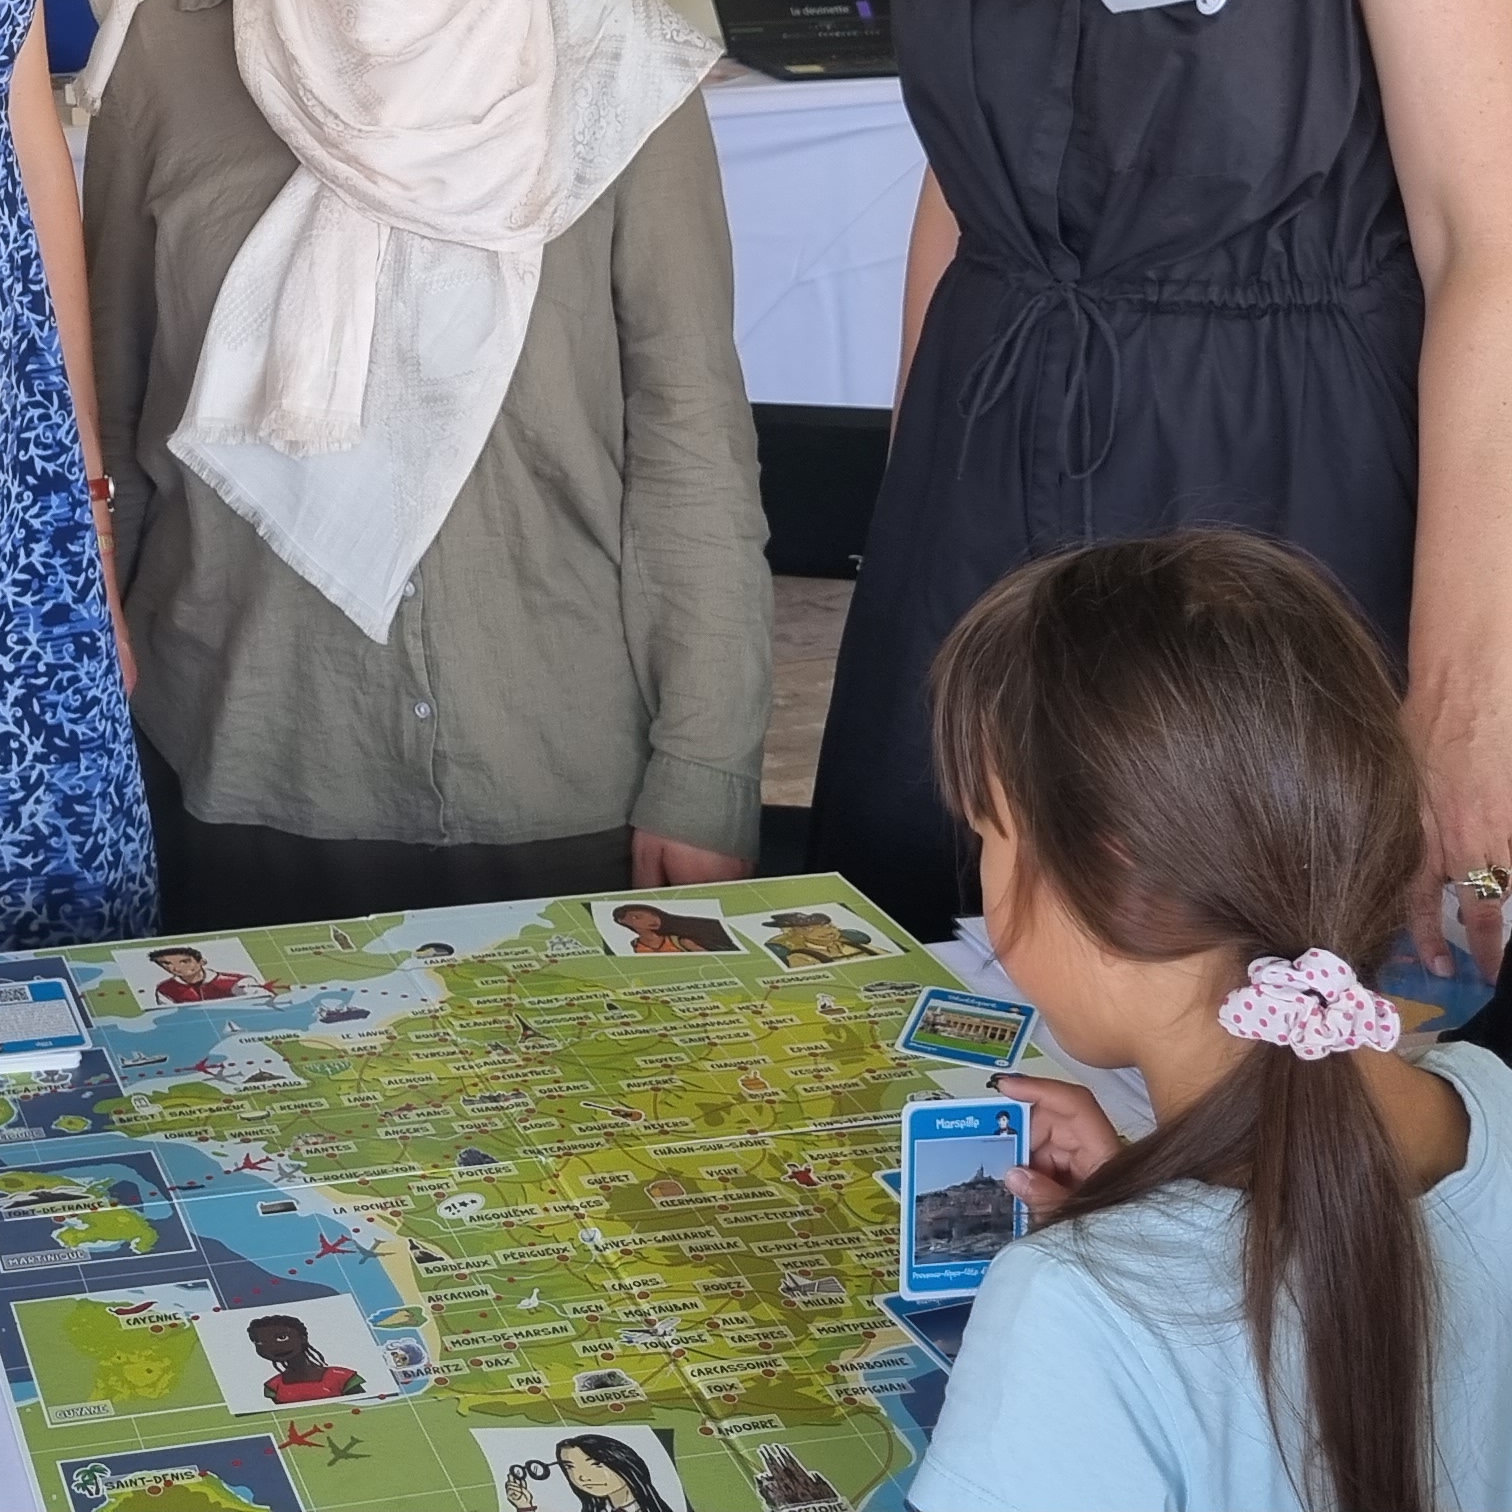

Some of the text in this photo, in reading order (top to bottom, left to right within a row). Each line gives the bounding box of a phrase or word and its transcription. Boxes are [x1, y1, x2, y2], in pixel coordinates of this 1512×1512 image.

[802, 4, 851, 16] devinette
[290, 942, 335, 953] LONDRES
[424, 956, 458, 966] CALAIS
[512, 962, 536, 970] LILLE
[480, 977, 506, 986] LENS
[763, 973, 830, 985] LUXEMBOURG
[476, 996, 516, 1006] AMIENS
[528, 993, 611, 1006] SAINT-QUENTIN
[670, 993, 705, 1003] SEDAN
[678, 1004, 720, 1014] VERDUN
[737, 1003, 768, 1012] METZ
[534, 1014, 592, 1025] SOISSONS
[762, 1017, 795, 1026] NANCY
[832, 1010, 902, 1022] STRASBOURG
[459, 1018, 512, 1029] BEAUVAIS
[239, 1033, 300, 1044] CHERBOURG
[358, 1028, 392, 1039] HAVRE
[414, 1031, 451, 1040] ROUEN
[679, 1031, 751, 1045] SAINT-DIZIER
[350, 1044, 378, 1053] CAEN
[523, 1042, 558, 1051] PARIS
[452, 1057, 518, 1072] VERSAILLES
[640, 1055, 685, 1065] TROYES
[710, 1057, 768, 1070] CHAUMONT
[501, 1068, 558, 1081] CHARTRES
[790, 1066, 835, 1077] VESOUL
[871, 1070, 915, 1081] BELFORT
[234, 1080, 302, 1093] SAINT-MALO
[626, 1077, 678, 1089] AUXERRE
[346, 1094, 378, 1104] LAVAL
[748, 1090, 781, 1100] DIJON
[168, 1104, 246, 1118] SAINT-BRIEUC
[279, 1100, 325, 1111] RENNES
[470, 1100, 530, 1114] CHAMBORD
[118, 1113, 155, 1123] BREST
[397, 1108, 450, 1120] LE MANS
[457, 1120, 499, 1131] TOURS
[522, 1121, 556, 1132] BLOIS
[577, 1121, 630, 1133] BOURGES
[643, 1119, 689, 1131] NEVERS
[935, 1115, 980, 1129] Marseille
[163, 1128, 210, 1139] LORIENT
[229, 1127, 276, 1138] VANNES
[384, 1125, 430, 1137] ANGERS
[305, 1143, 352, 1155] NANTES
[302, 1164, 417, 1184] LA-ROCHE-SUR-YON
[458, 1165, 513, 1179] POITIERS
[705, 1167, 739, 1178] VICHY
[817, 1172, 846, 1183] LYON
[416, 1182, 451, 1192] NIORT
[659, 1190, 775, 1208] CLERMONT-FERRAND
[7, 1200, 106, 1218] FORT-DE-FRANCE
[332, 1199, 409, 1215] LA ROCHELLE
[552, 1199, 604, 1213] LIMOGES
[594, 1230, 715, 1252] BRIVE-LA-GAILLARDE
[757, 1235, 863, 1254] LE-PUY-EN-VELAY
[502, 1245, 571, 1262] PÉRIGUEUX
[688, 1241, 741, 1254] AURILLAC
[8, 1250, 87, 1266] MARTINIQUE
[782, 1258, 825, 1270] MENDE
[423, 1259, 492, 1275] BORDEAUX
[610, 1277, 660, 1291] CAHORS
[702, 1281, 746, 1292] RODEZ
[427, 1288, 490, 1304] ARCACHON
[801, 1296, 845, 1308] MILLAU
[572, 1303, 604, 1315] AGEN
[622, 1301, 699, 1318] MONTAUBAN
[126, 1312, 182, 1325] CAYENNE
[721, 1315, 749, 1326] ALBI
[450, 1324, 569, 1347] MONT-DE-MARSAN
[730, 1330, 788, 1344] CASTRES
[581, 1342, 614, 1354] AUCH
[640, 1333, 708, 1351] TOULOUSE
[486, 1357, 513, 1368] DAX
[690, 1358, 782, 1378] CARCASSONNE
[840, 1357, 909, 1372] NARBONNE
[402, 1363, 464, 1378] BIARRITZ
[516, 1376, 543, 1387] PAU
[706, 1382, 739, 1394] FOIX
[835, 1382, 907, 1398] PERPIGNAN
[579, 1389, 641, 1405] LOURDES
[56, 1404, 108, 1419] GUYANE
[716, 1419, 779, 1436] ANDORRE
[104, 1470, 196, 1491] SAINT-DENIS
